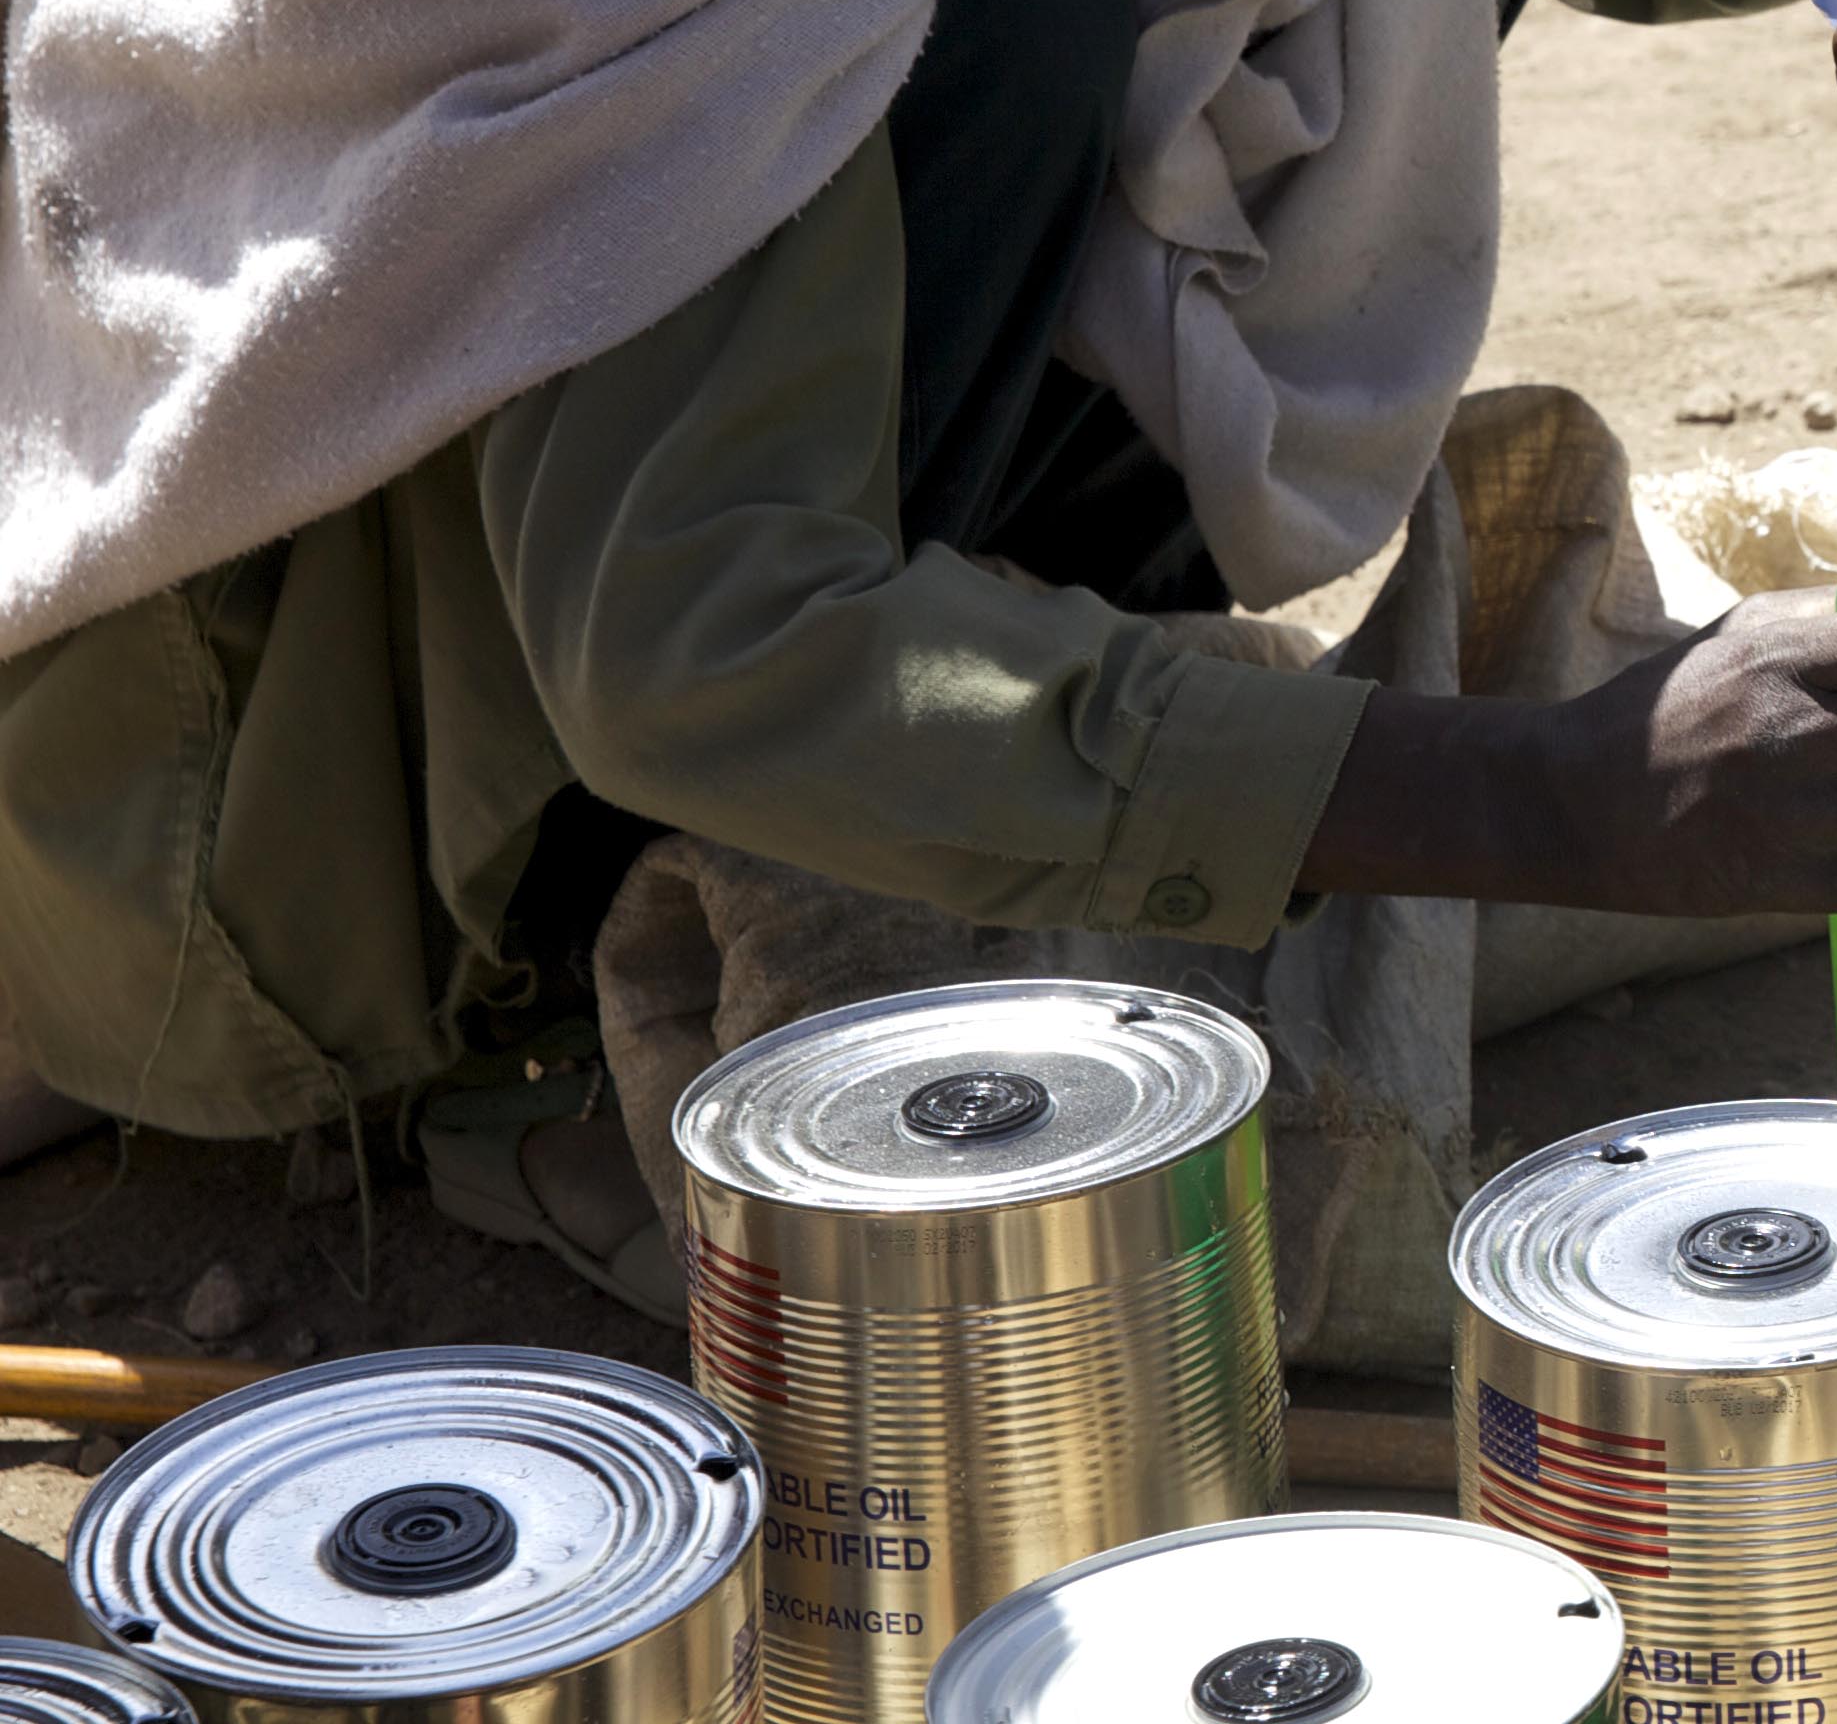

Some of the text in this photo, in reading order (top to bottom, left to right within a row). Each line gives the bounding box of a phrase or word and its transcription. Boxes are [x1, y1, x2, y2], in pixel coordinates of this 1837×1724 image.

[859, 1486, 927, 1522] OIL
[763, 1515, 932, 1572] ORTIFIED
[763, 1588, 925, 1636] EXCHANGED
[1623, 1645, 1824, 1686] ABLE OIL
[1623, 1695, 1827, 1724] ORTIFIED
